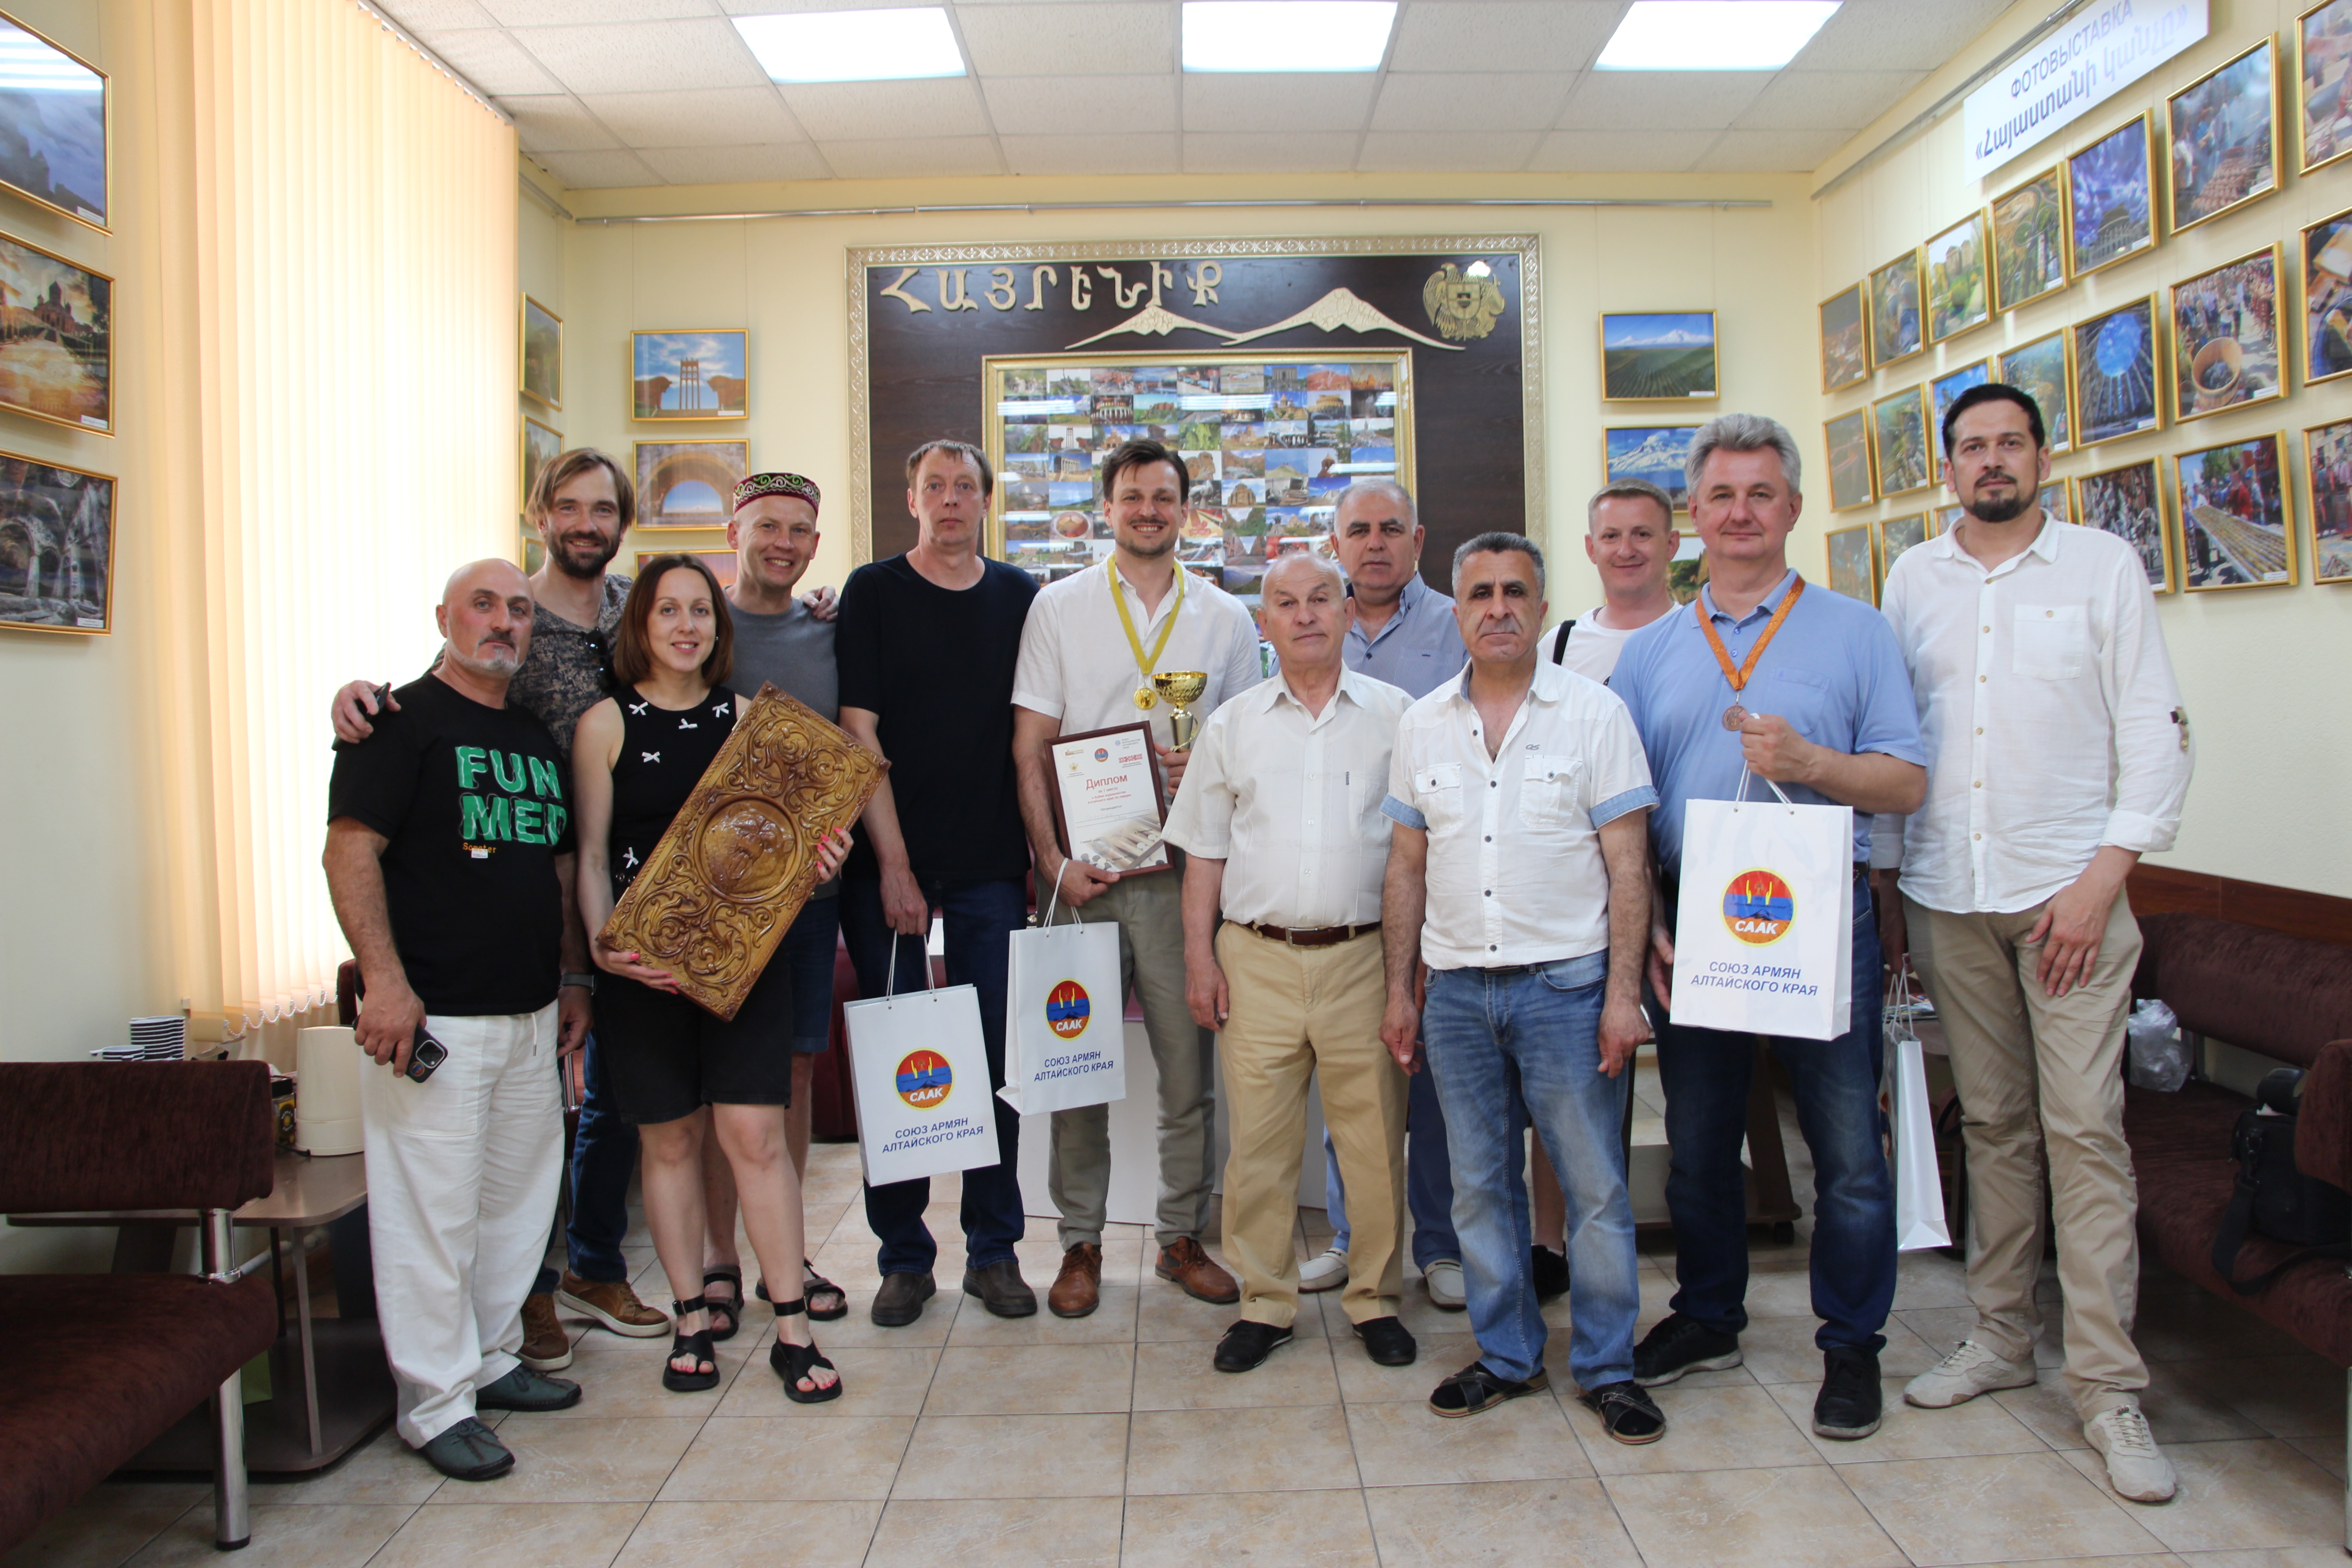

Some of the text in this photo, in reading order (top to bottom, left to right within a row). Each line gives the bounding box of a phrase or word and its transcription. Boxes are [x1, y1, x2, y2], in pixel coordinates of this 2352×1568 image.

[2011, 0, 2134, 99] ФОТОВЫСТАВКА
[1976, 59, 2097, 160] «Հայաստանի
[880, 260, 1223, 314] ՀԱՅՐԵՆԻՔ
[455, 745, 563, 802] FUN
[1086, 774, 1127, 790] Диплом
[1735, 920, 1779, 935] СААК
[1709, 961, 1801, 979] СОЮЗ АРМЯН
[1691, 974, 1818, 996] АЛТАЙСКОГО КРАЯ
[1056, 1019, 1082, 1032] СААК
[1044, 1051, 1101, 1068] СОЮЗ АРМЯН
[1034, 1061, 1113, 1082] АЛТАЙСКОГО КРАЯ
[909, 1087, 943, 1102] СААК
[895, 1117, 968, 1138] СОЮЗ АРМЯН
[882, 1126, 983, 1153] АЛТАЙСКОГО КРАЯ
